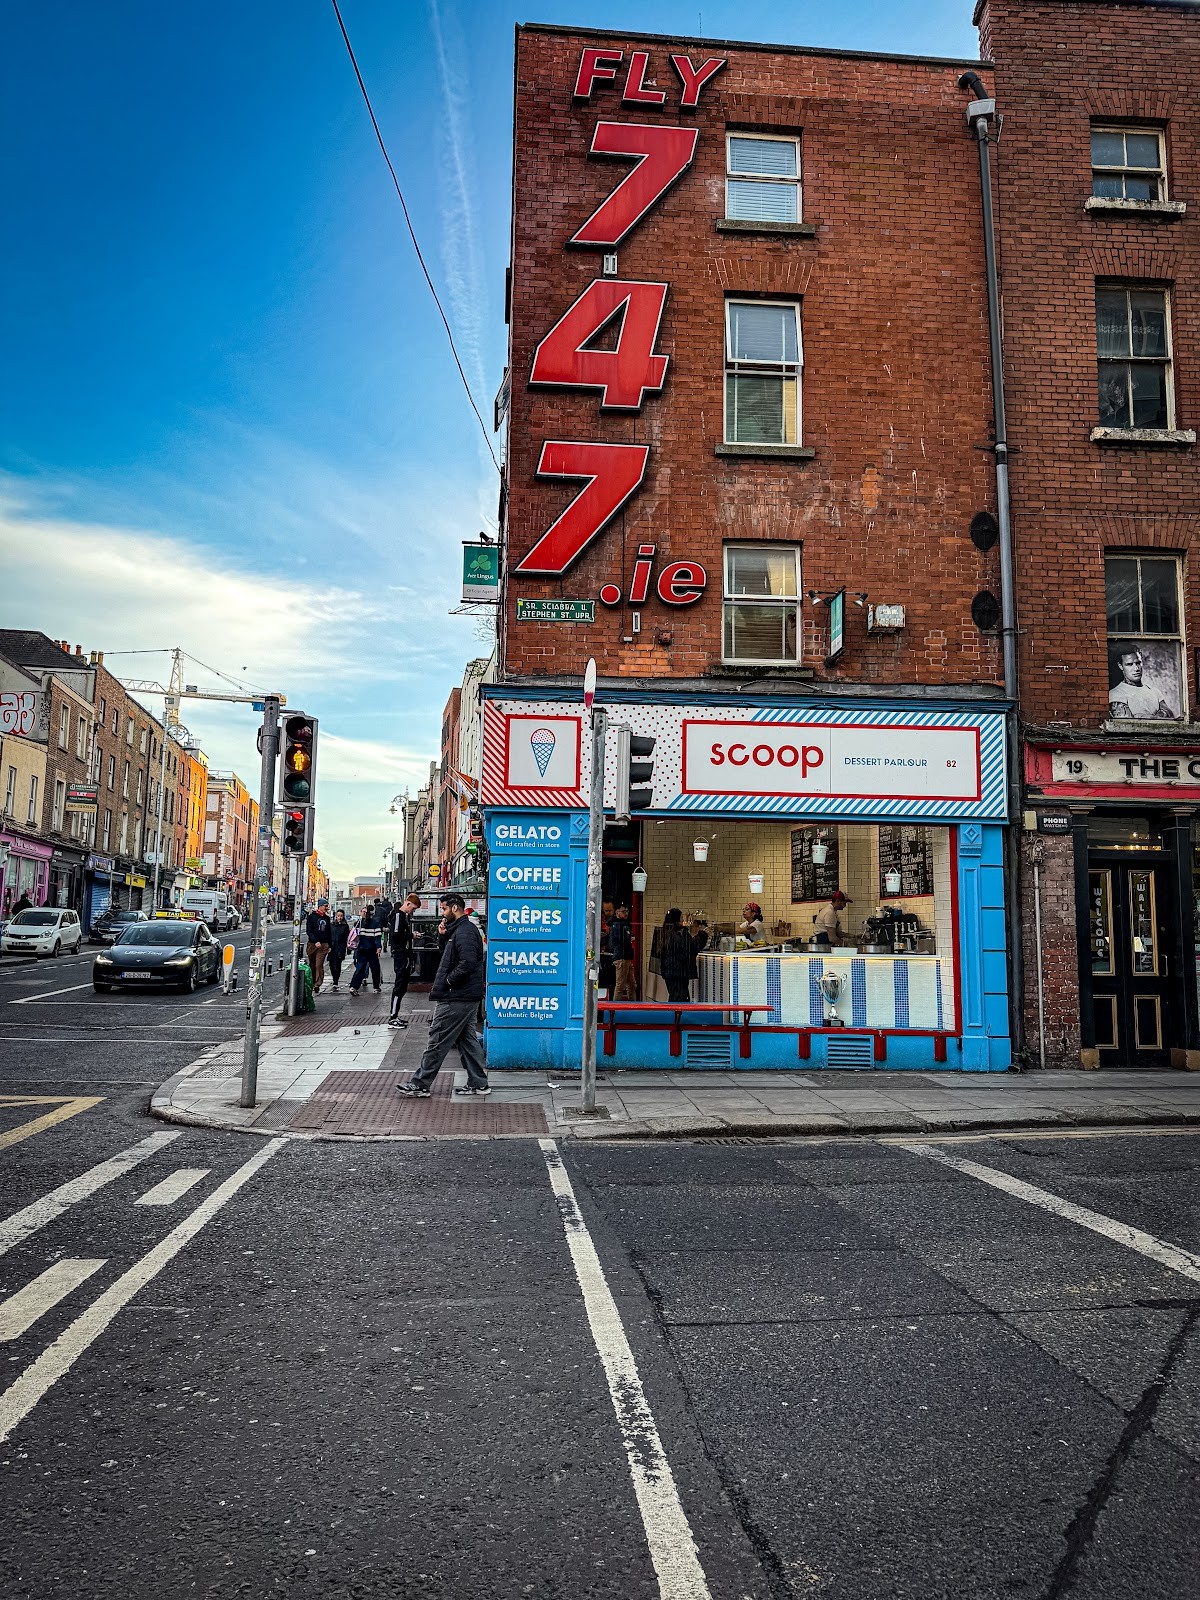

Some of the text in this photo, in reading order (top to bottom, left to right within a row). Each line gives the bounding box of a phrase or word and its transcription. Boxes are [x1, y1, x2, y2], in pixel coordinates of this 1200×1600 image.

[573, 47, 727, 107] FLY
[599, 544, 708, 606] .ie
[521, 610, 556, 619] STEPHEN
[710, 743, 824, 778] scoop
[844, 757, 928, 767] DESSERT PARLOUR
[946, 760, 957, 768] 82
[1066, 760, 1083, 774] 19
[1119, 758, 1180, 778] THE
[495, 825, 561, 840] GELATO
[513, 840, 536, 848] crafted
[495, 867, 562, 882] COFFEE
[496, 905, 562, 925] CRÊPES
[493, 951, 560, 967] SHAKES
[511, 968, 532, 976] Organic
[492, 996, 559, 1011] WAFFLES
[529, 1011, 554, 1020] Belgian
